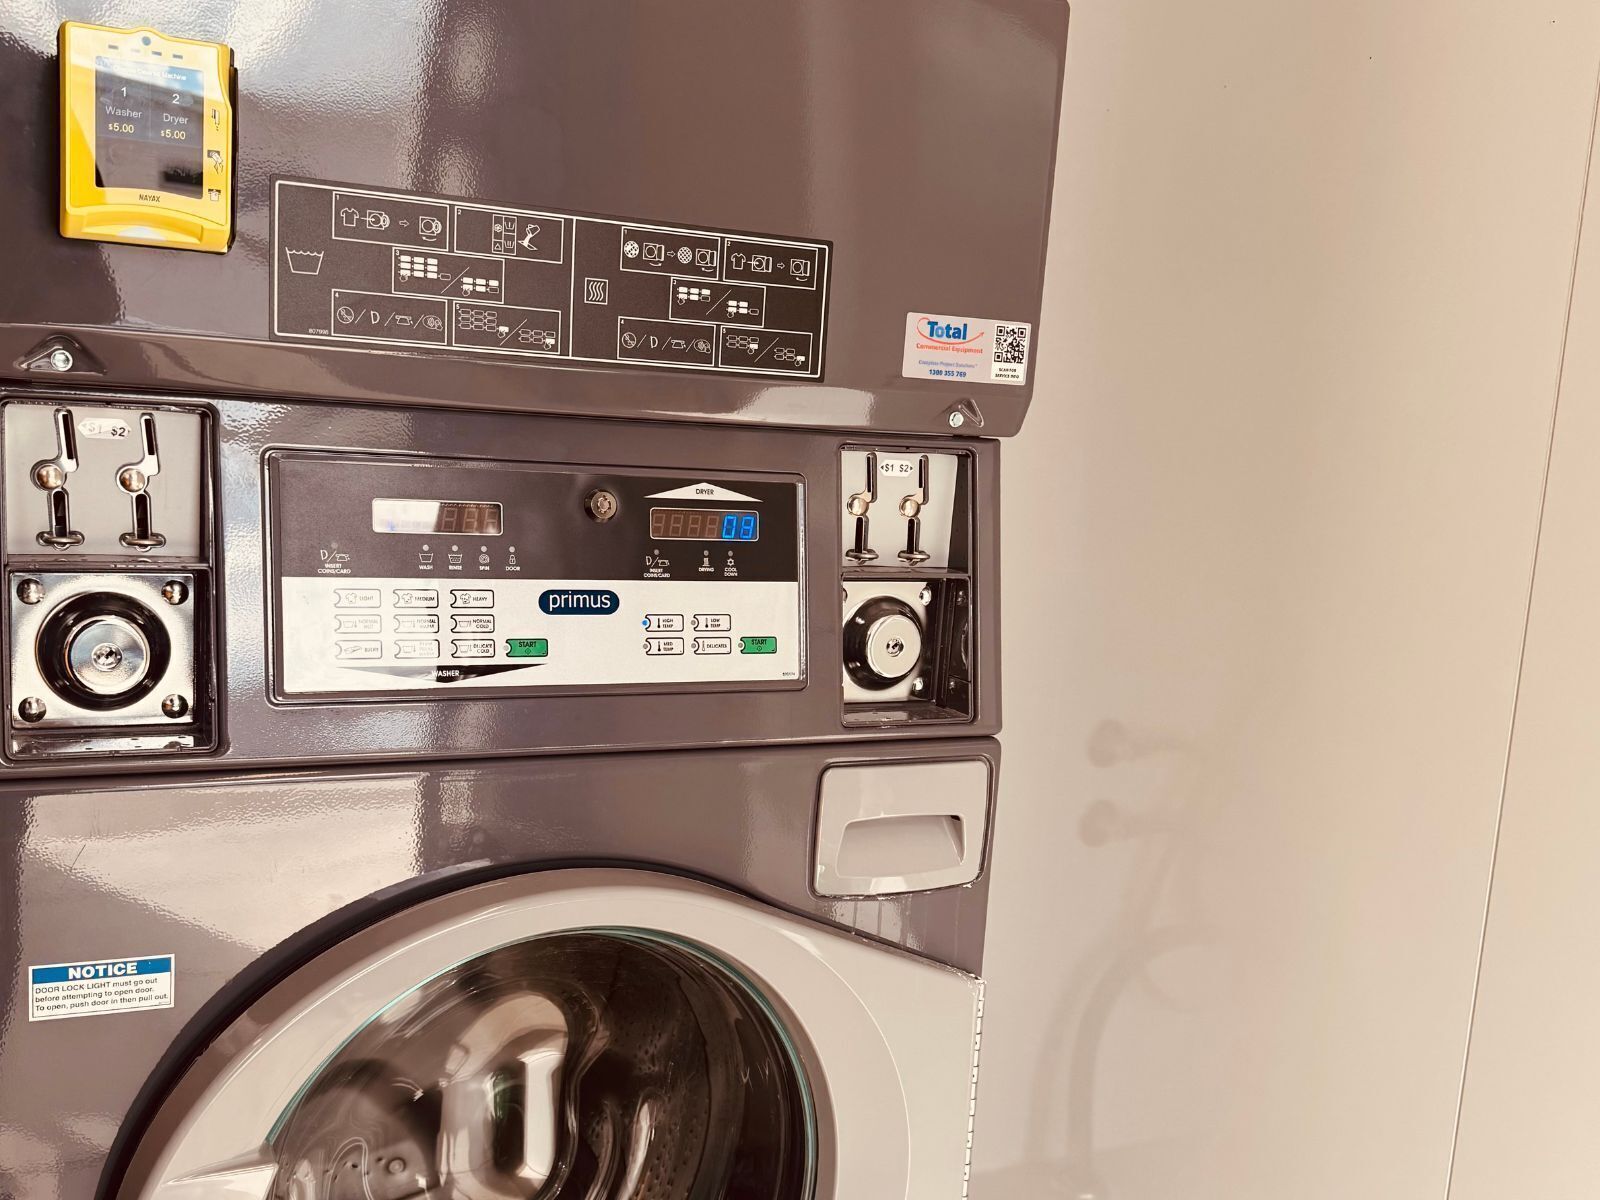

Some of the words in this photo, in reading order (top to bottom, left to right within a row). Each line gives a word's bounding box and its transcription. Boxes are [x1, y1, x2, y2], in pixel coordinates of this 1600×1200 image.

[121, 87, 127, 97] 1
[172, 94, 180, 104] 2
[105, 105, 142, 119] Washer
[163, 113, 188, 126] Dryer
[108, 123, 134, 133] $5.00
[160, 129, 186, 140] $5.00
[139, 194, 160, 203] NAYAX
[927, 320, 968, 340] Total
[916, 343, 951, 352] Commercial
[951, 346, 983, 354] Equipment
[111, 425, 126, 437] $2
[884, 463, 894, 473] $1
[899, 463, 909, 473] $2
[695, 488, 714, 496] DRYER
[722, 515, 755, 539] 09
[549, 591, 611, 611] primus
[68, 962, 138, 980] NOTICE
[35, 986, 60, 994] DOOR
[61, 983, 85, 992] LOCK
[87, 981, 112, 990] LIGHT
[35, 995, 60, 1003] before
[61, 991, 103, 1001] attempting
[115, 988, 134, 997] open
[135, 986, 155, 994] door.
[46, 1003, 69, 1012] open,
[70, 1001, 89, 1010] push
[91, 998, 108, 1006] door
[120, 996, 137, 1004] then
[138, 994, 153, 1003] pull
